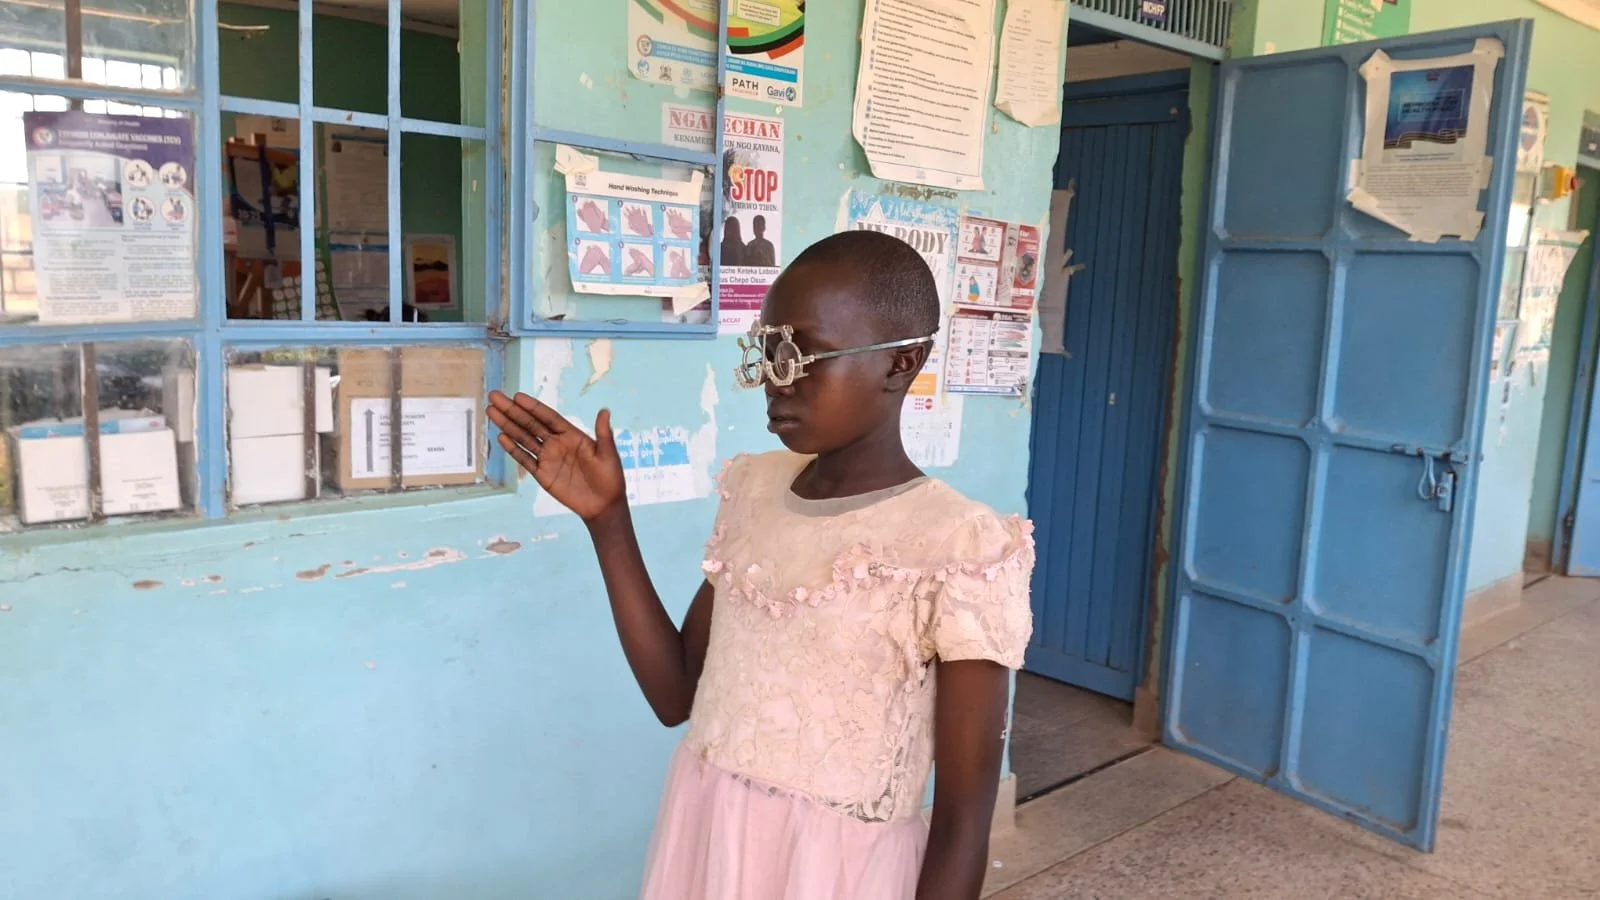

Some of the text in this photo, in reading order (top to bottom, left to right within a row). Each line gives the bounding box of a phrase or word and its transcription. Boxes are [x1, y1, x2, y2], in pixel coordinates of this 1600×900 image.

[732, 78, 759, 90] PATH
[767, 86, 785, 97] Gavi
[729, 165, 779, 202] STOP
[608, 183, 679, 198] Hand Washing Technique
